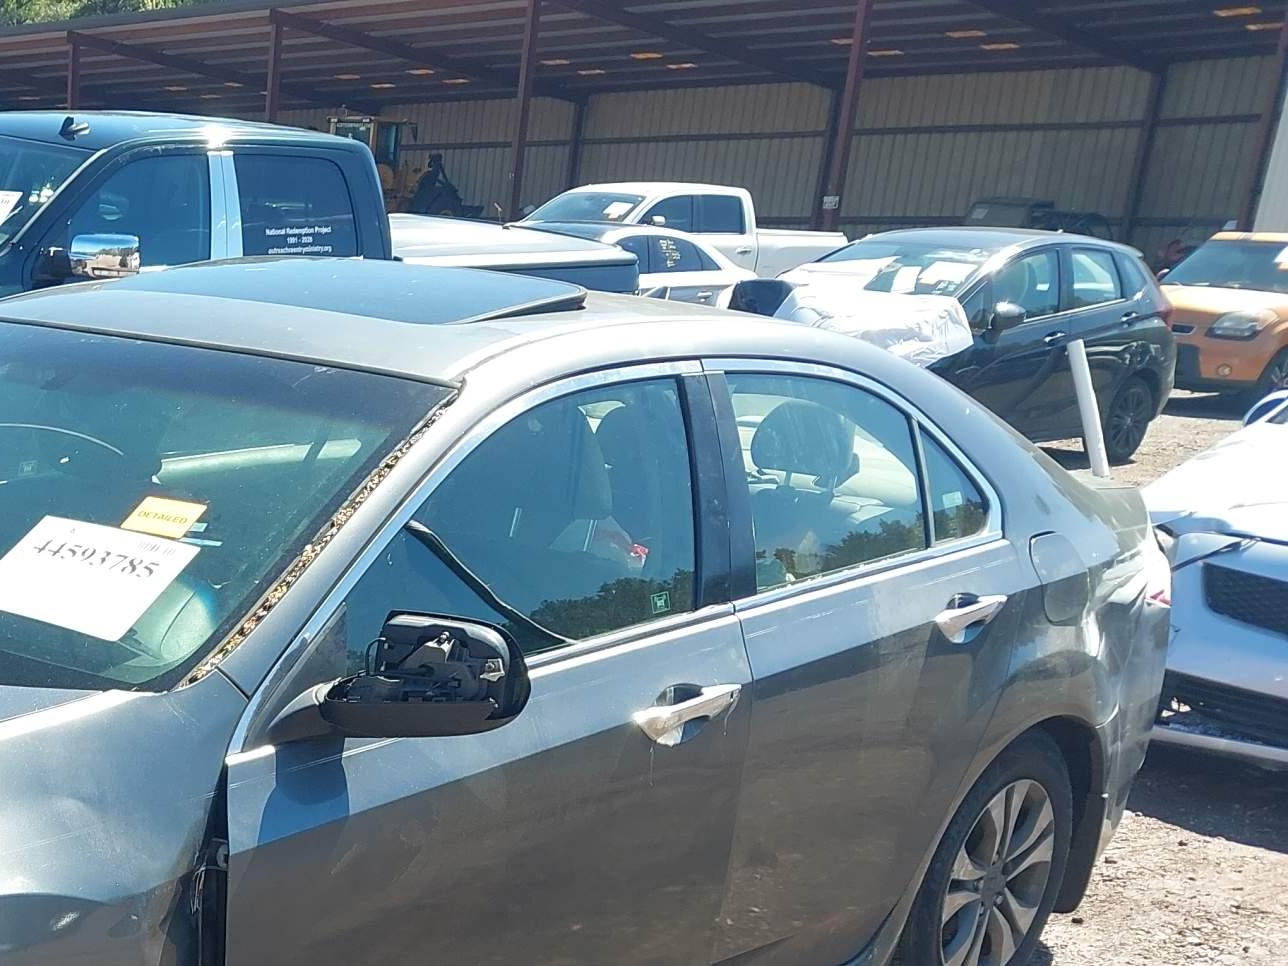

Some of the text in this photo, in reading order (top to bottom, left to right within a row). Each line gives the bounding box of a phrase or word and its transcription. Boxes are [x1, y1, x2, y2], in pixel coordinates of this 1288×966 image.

[265, 226, 332, 236] National Redemption Project
[137, 509, 189, 525] DETAILED
[33, 539, 160, 578] 44593785
